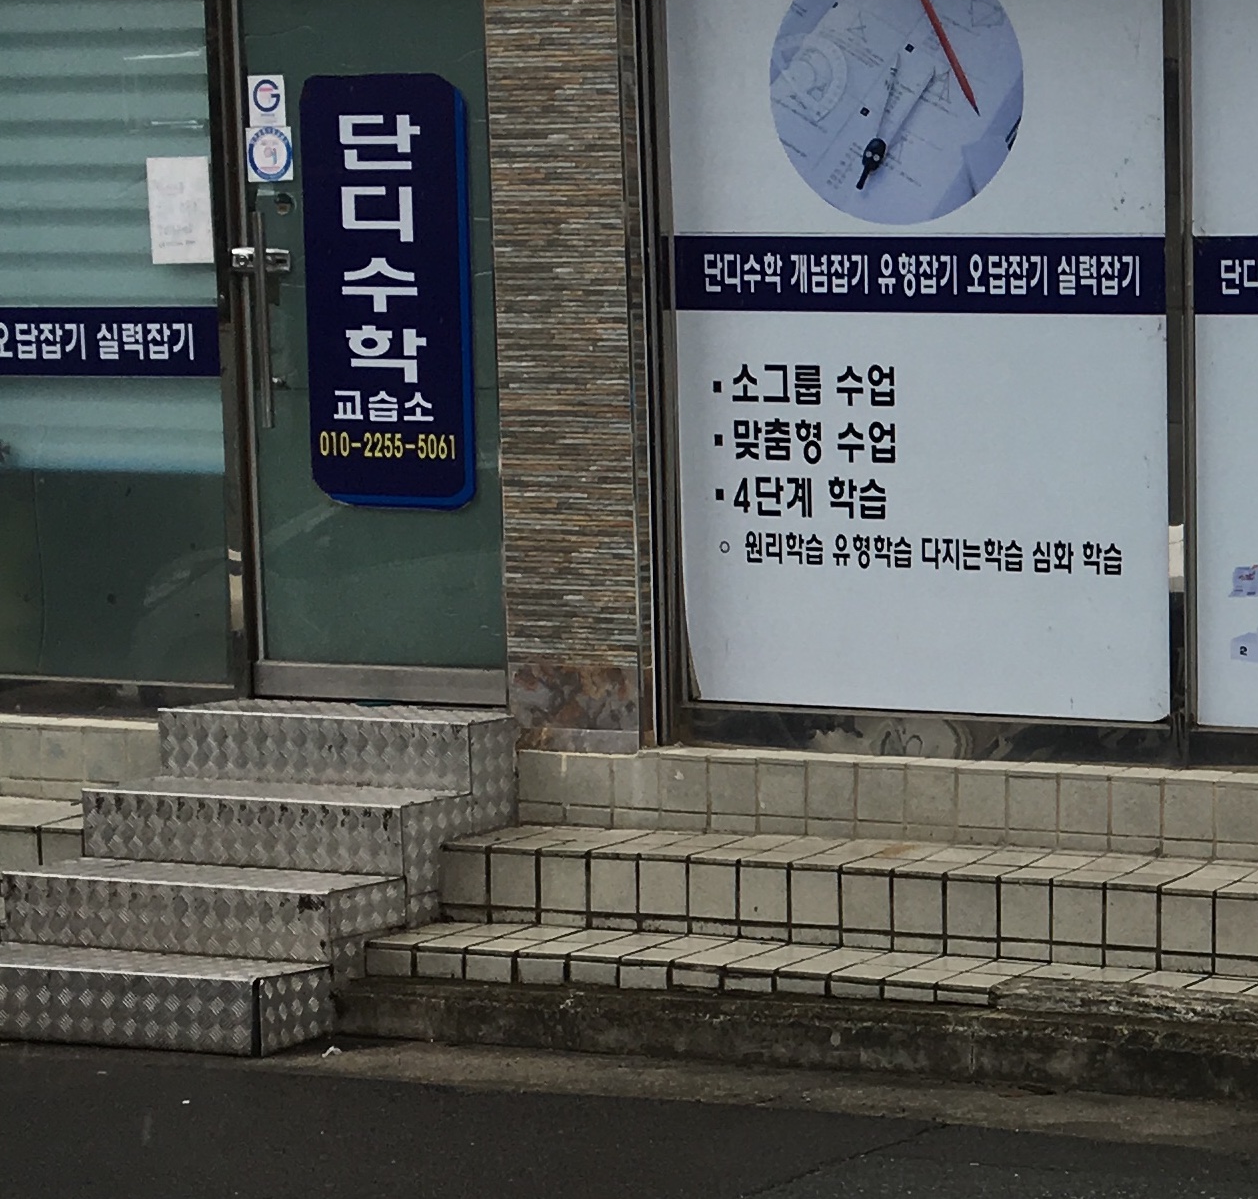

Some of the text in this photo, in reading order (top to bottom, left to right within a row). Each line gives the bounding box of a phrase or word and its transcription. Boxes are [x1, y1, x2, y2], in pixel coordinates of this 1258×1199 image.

[339, 115, 426, 383] 단디수학
[704, 253, 1139, 296] 단디수학 개념잡기 유형잡기 오답잡기 실력잡기
[97, 323, 194, 360] 실력잡기
[334, 391, 434, 421] 교습소
[732, 364, 894, 406] 소그룹 수업
[320, 431, 455, 459] 010-2255-5061
[734, 418, 895, 464] 맞춤형 수업
[734, 477, 886, 519] 4단계 학습
[745, 531, 1122, 575] 원리학습 유형학습 다지는학습 심화 학습
